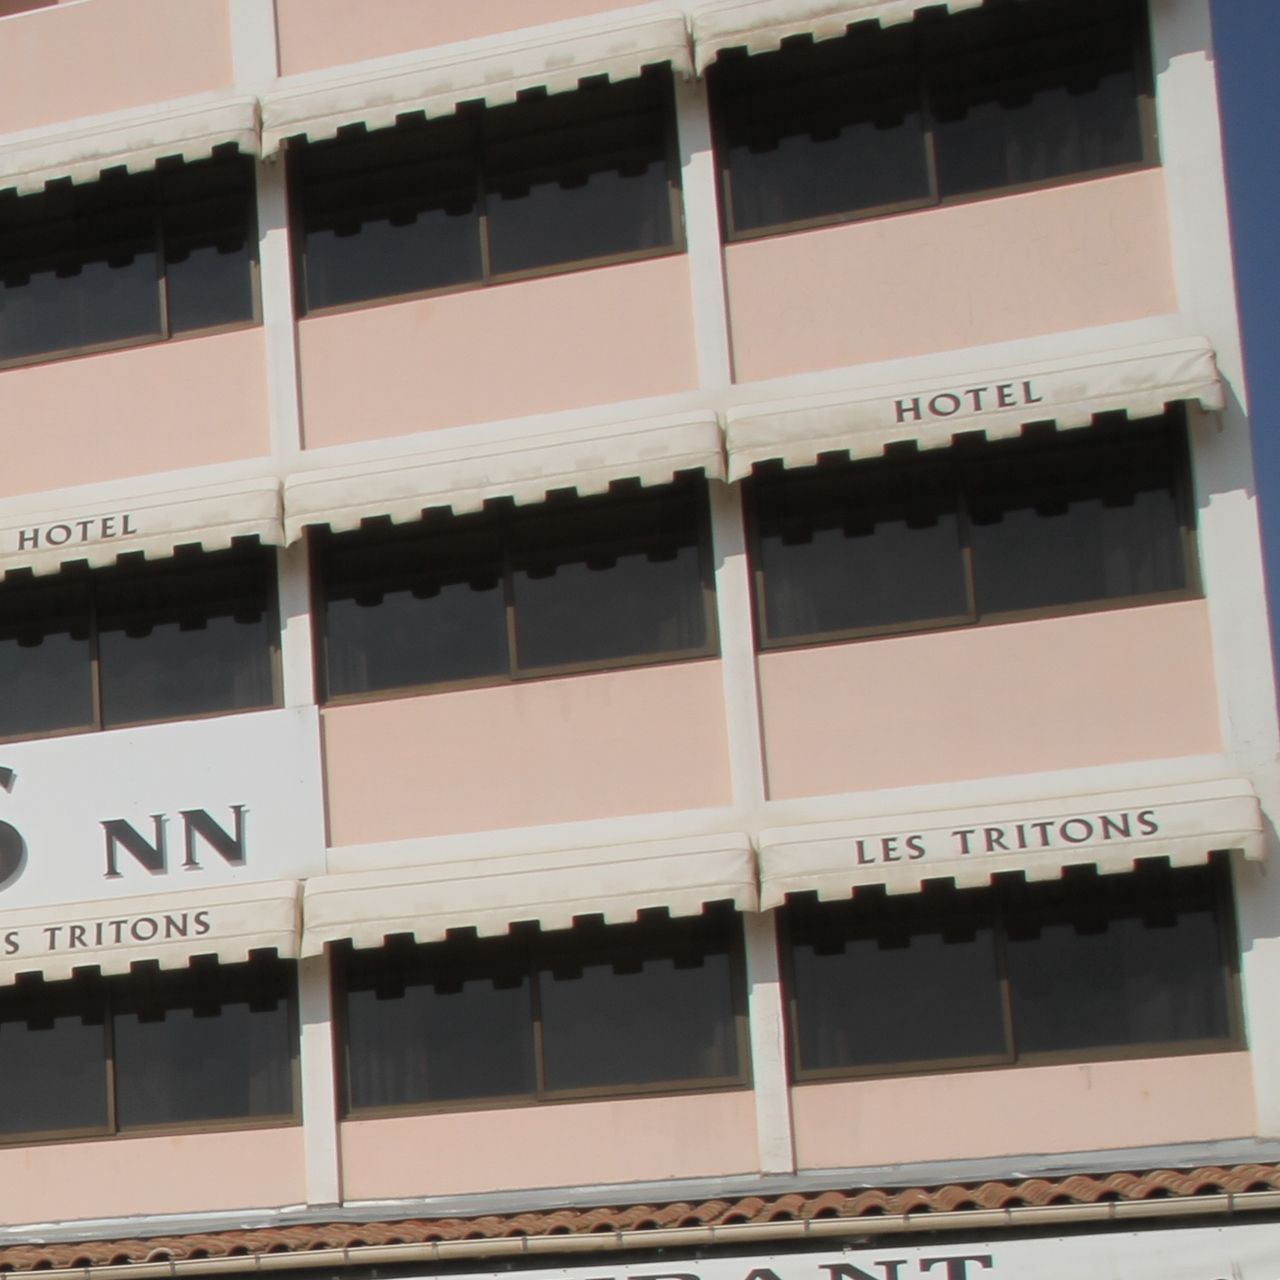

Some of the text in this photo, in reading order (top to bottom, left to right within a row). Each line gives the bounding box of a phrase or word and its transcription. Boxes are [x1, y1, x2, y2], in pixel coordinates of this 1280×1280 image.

[894, 380, 1044, 423] HOTEL
[17, 514, 137, 551] HOTEL
[100, 804, 245, 877] NN
[856, 809, 1160, 865] LES TRITONS
[43, 910, 211, 951] TRITONS
